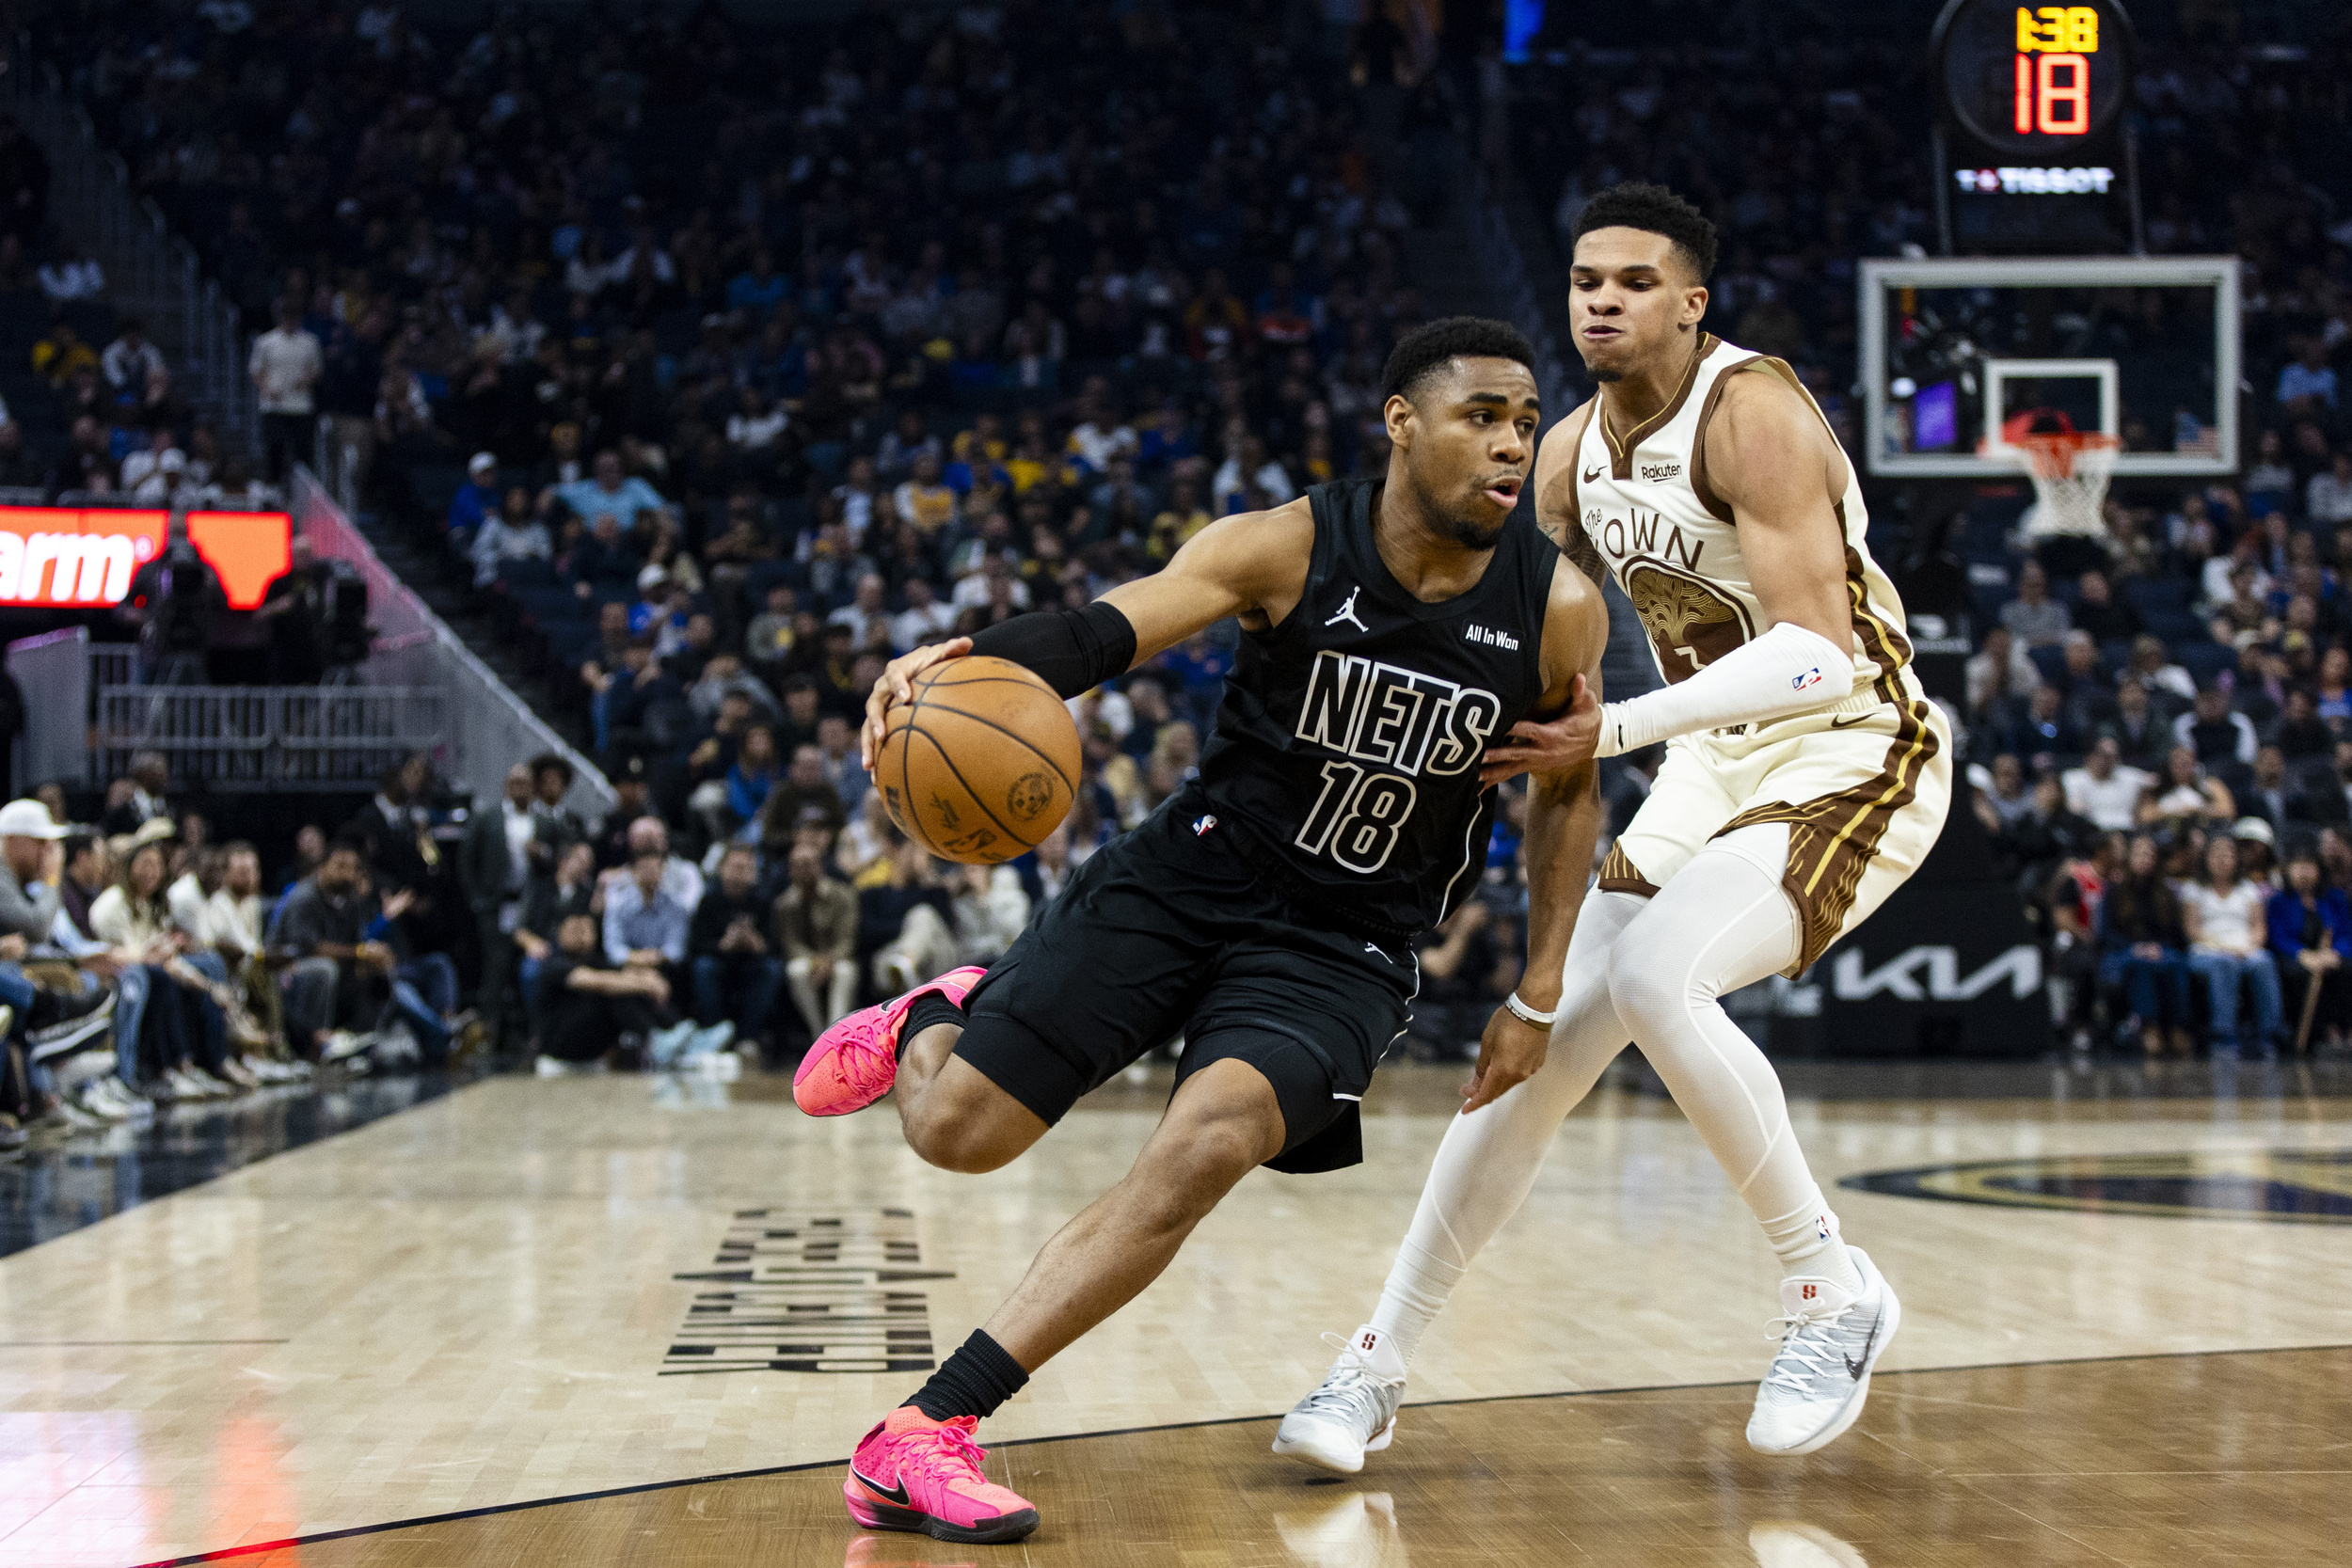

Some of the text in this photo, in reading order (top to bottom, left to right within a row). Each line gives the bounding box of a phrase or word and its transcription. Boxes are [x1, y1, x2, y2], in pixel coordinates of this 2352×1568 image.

[2016, 7, 2099, 53] 1:38
[2014, 53, 2090, 135] 18
[1641, 464, 1682, 480] Rakuten
[1585, 508, 1603, 538] The
[1594, 507, 1705, 573] OWN
[1465, 624, 1519, 651] All In Won
[1295, 650, 1502, 777] NETS
[1295, 760, 1417, 874] 18
